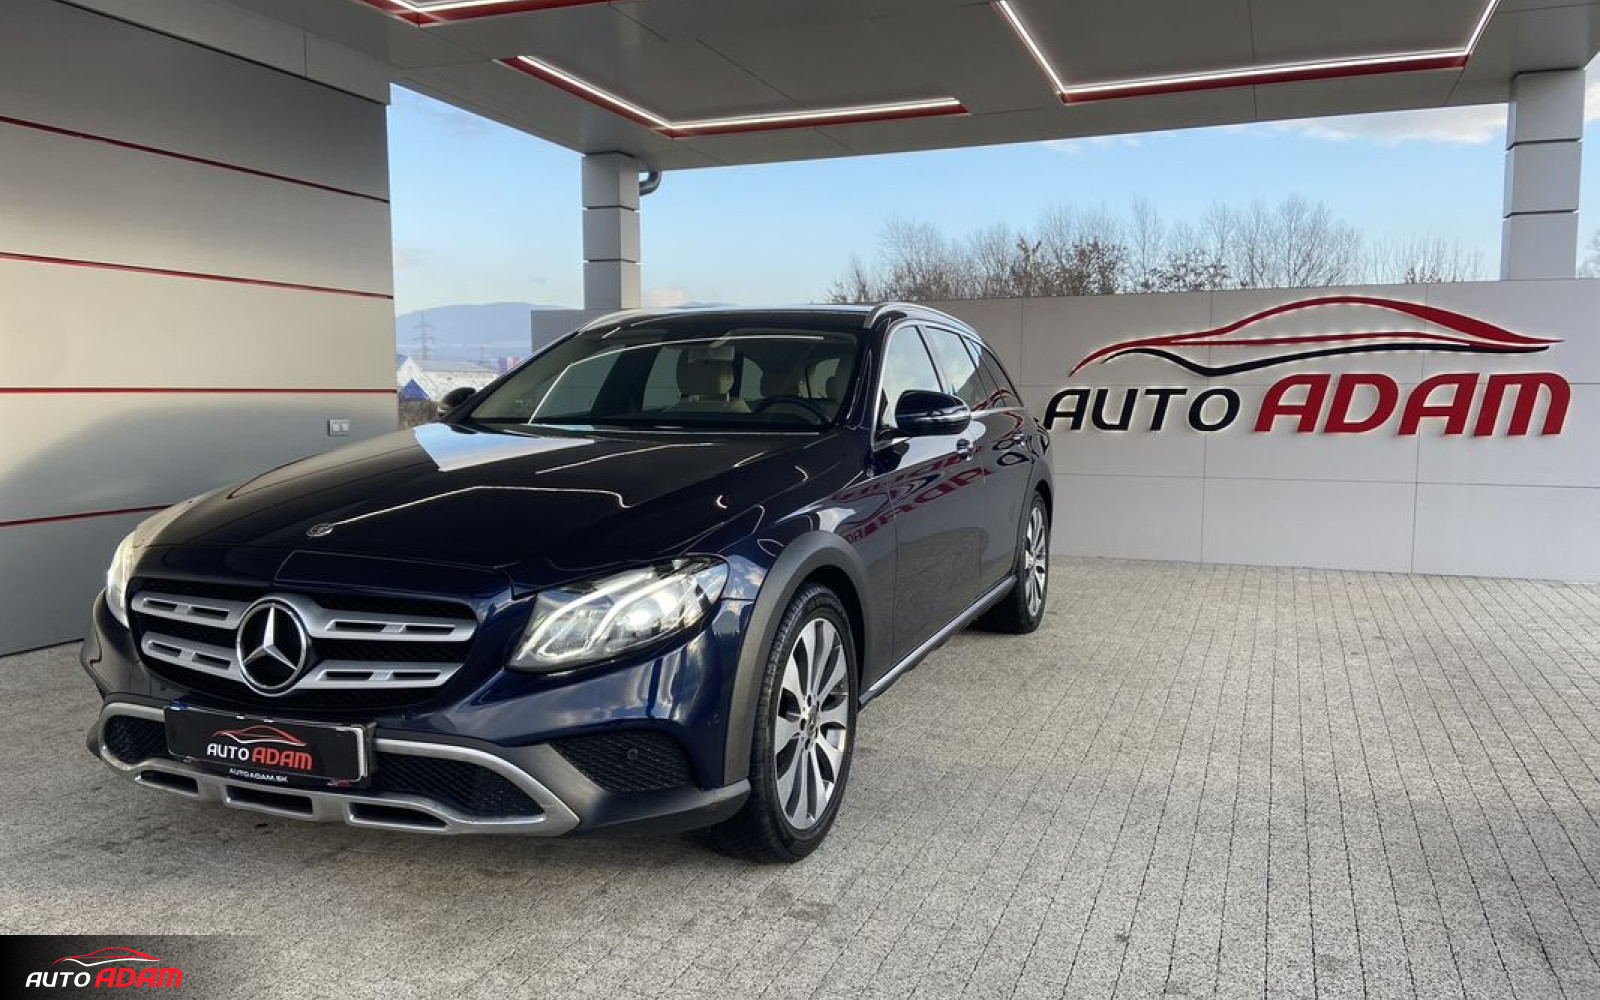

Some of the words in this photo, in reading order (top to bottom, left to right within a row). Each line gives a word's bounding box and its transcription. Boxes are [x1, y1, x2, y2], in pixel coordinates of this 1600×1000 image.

[1044, 387, 1241, 432] AUTO
[1253, 372, 1571, 437] ADAM
[206, 742, 250, 762] AUTO
[252, 746, 313, 771] ADAM
